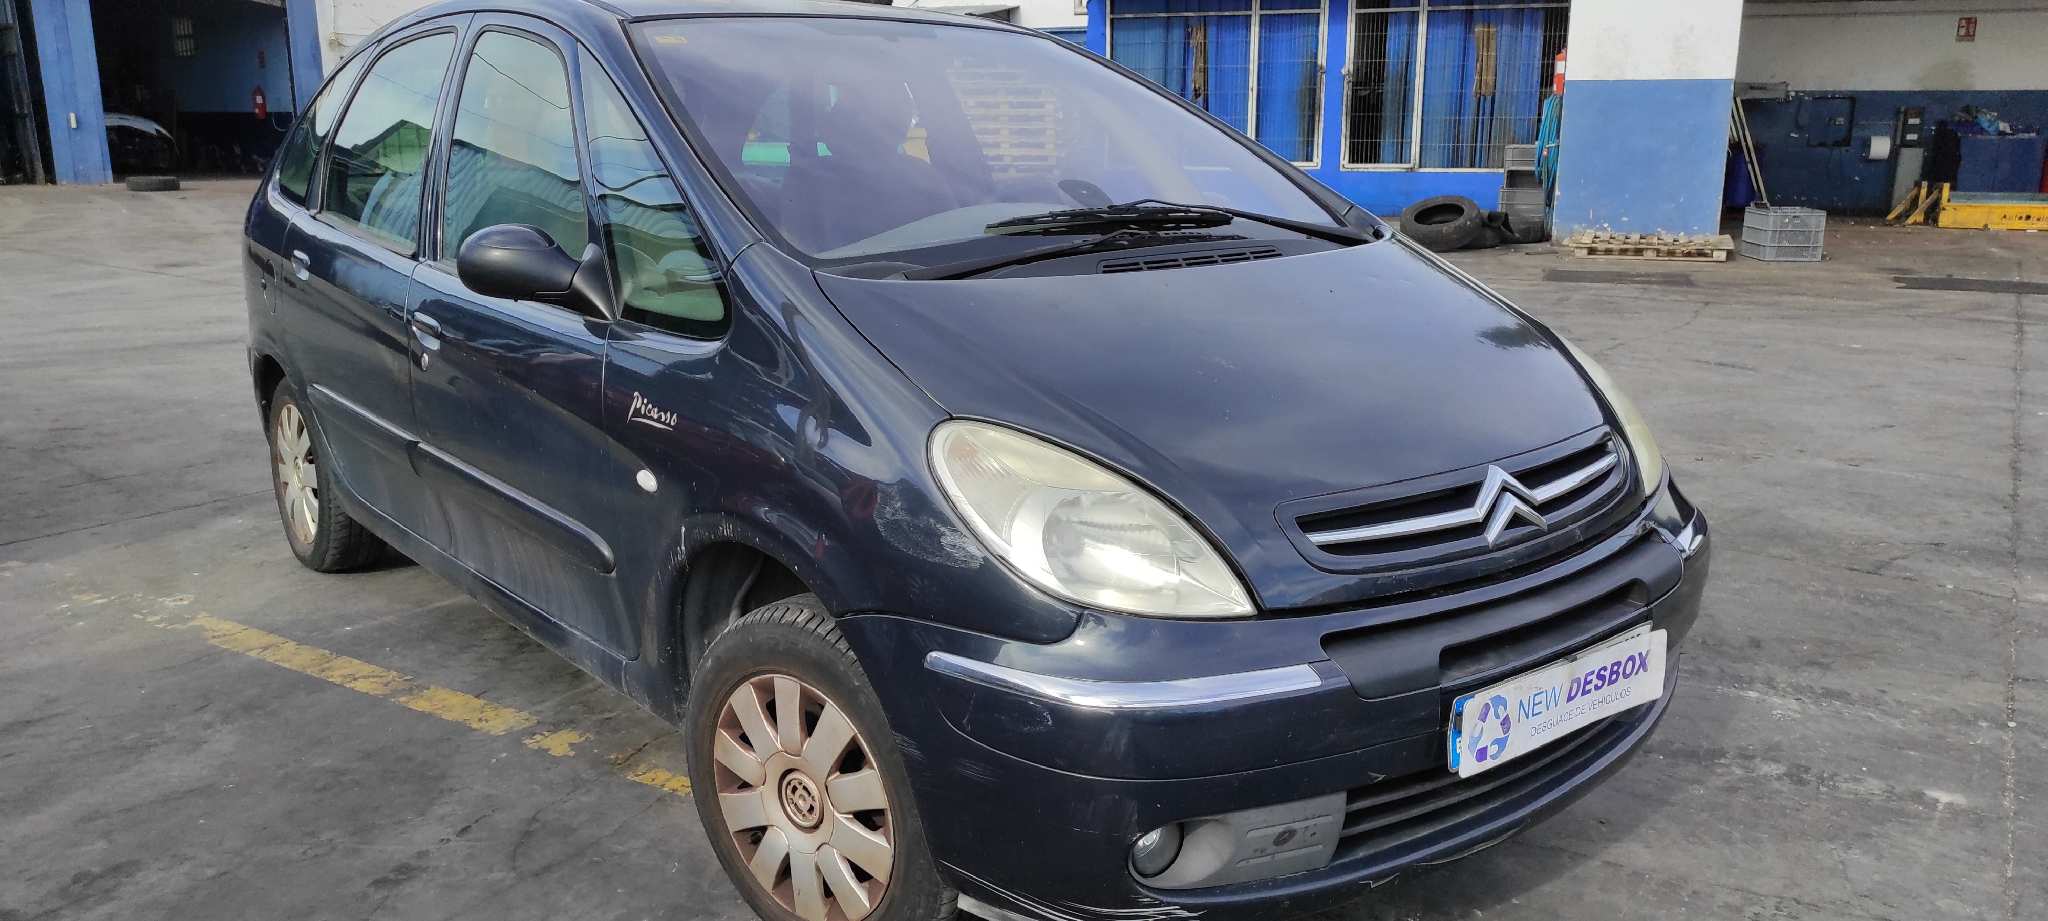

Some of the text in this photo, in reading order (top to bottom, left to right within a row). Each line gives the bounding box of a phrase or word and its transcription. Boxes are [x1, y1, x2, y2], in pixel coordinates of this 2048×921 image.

[1518, 649, 1650, 723] NEW DESBOX
[1575, 703, 1586, 717] DE
